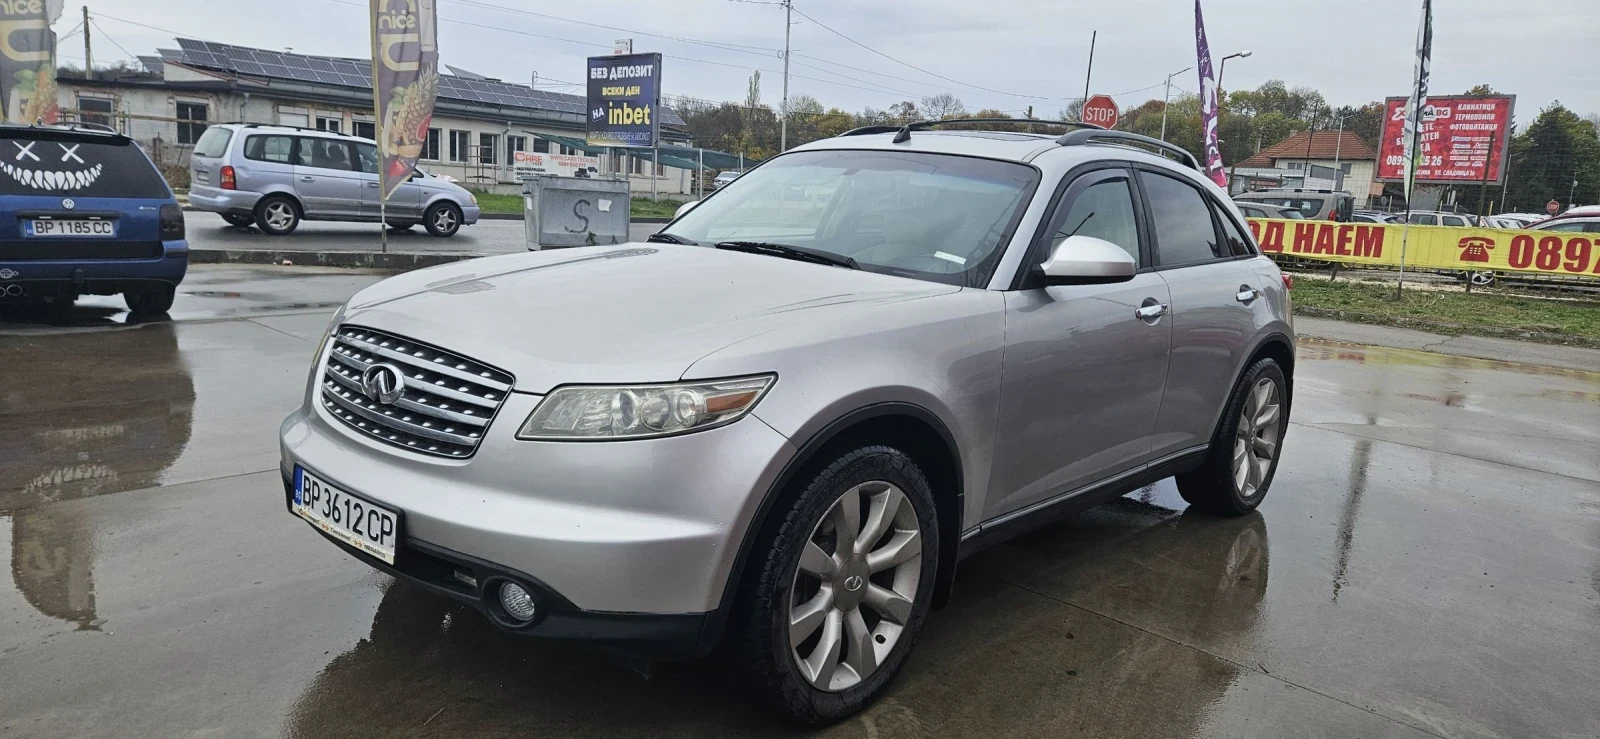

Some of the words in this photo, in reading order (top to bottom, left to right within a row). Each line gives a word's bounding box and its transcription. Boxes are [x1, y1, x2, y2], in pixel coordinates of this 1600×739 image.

[378, 9, 416, 29] nice
[590, 67, 608, 79] БЕЗ
[609, 65, 654, 80] ДЕПОЗИТ
[602, 86, 624, 96] ВСЕКИ
[625, 86, 640, 97] ДЕН
[592, 107, 605, 119] НА
[608, 101, 651, 125] inbet
[1086, 107, 1114, 122] STOP
[1458, 103, 1495, 111] КЛИМАТИЦИ
[514, 152, 543, 164] CARE
[564, 199, 591, 234] S
[35, 221, 54, 234] BP
[60, 221, 91, 234] 1185
[93, 221, 111, 234] CC
[1292, 222, 1386, 258] НАЕМ
[303, 474, 320, 509] BP
[322, 487, 364, 536] 3612
[367, 509, 393, 545] CP
